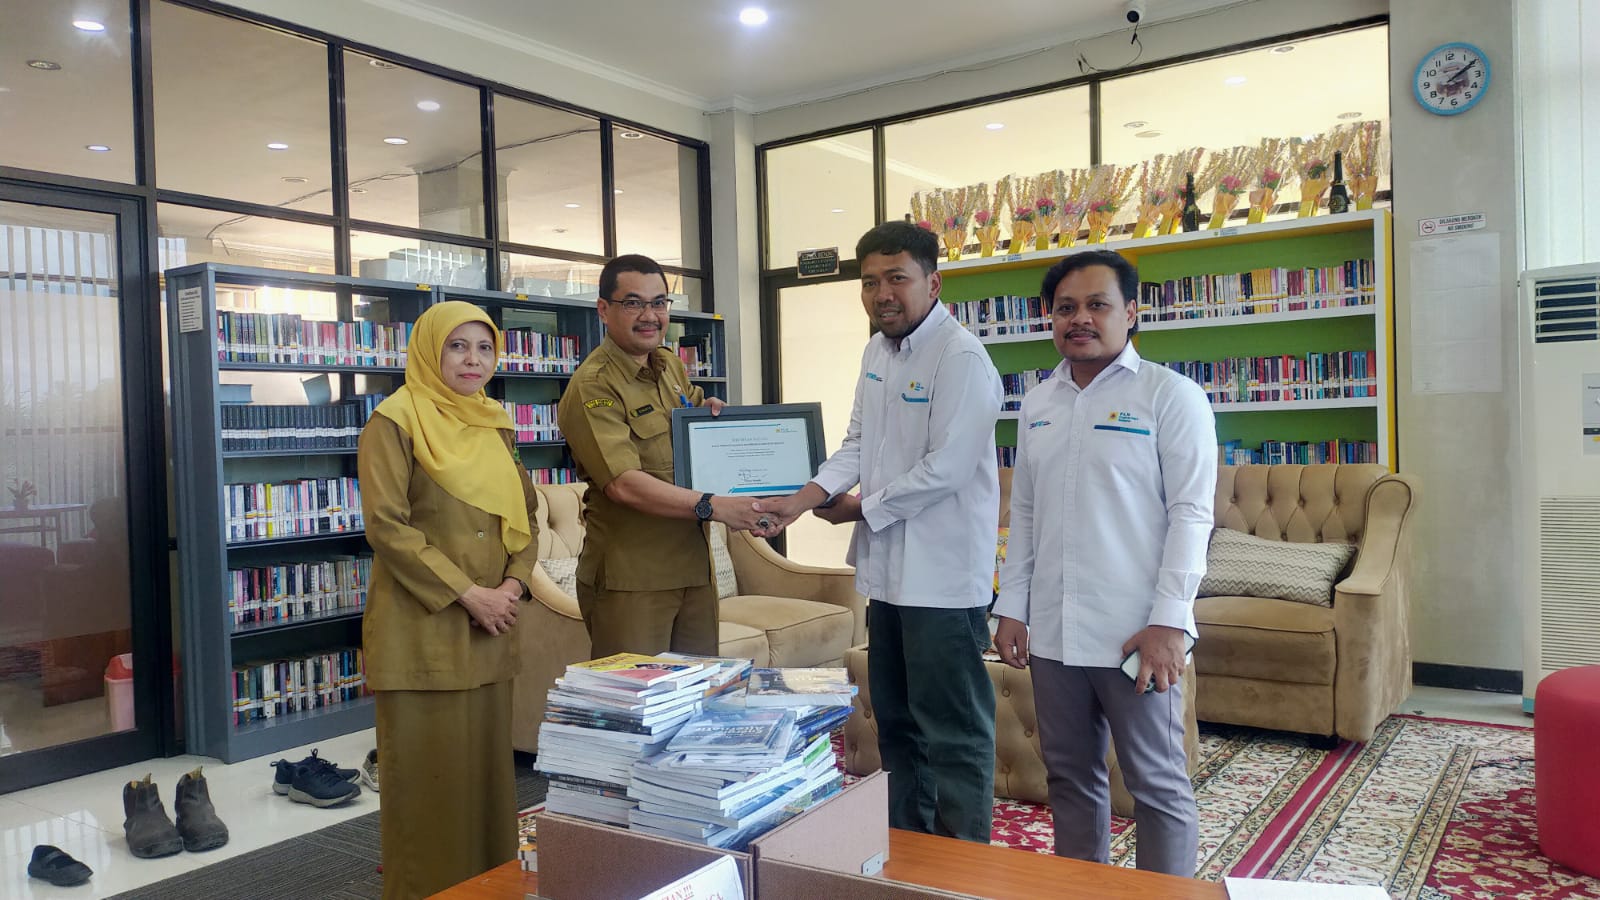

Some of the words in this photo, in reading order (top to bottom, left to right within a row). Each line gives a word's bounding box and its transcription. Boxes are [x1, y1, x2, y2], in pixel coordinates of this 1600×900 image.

[1445, 53, 1455, 61] 12
[1426, 69, 1437, 78] 10
[1474, 70, 1481, 78] 3
[1423, 81, 1430, 89] 9
[1464, 91, 1472, 99] 5
[1438, 97, 1445, 105] 7
[1450, 98, 1458, 106] 6
